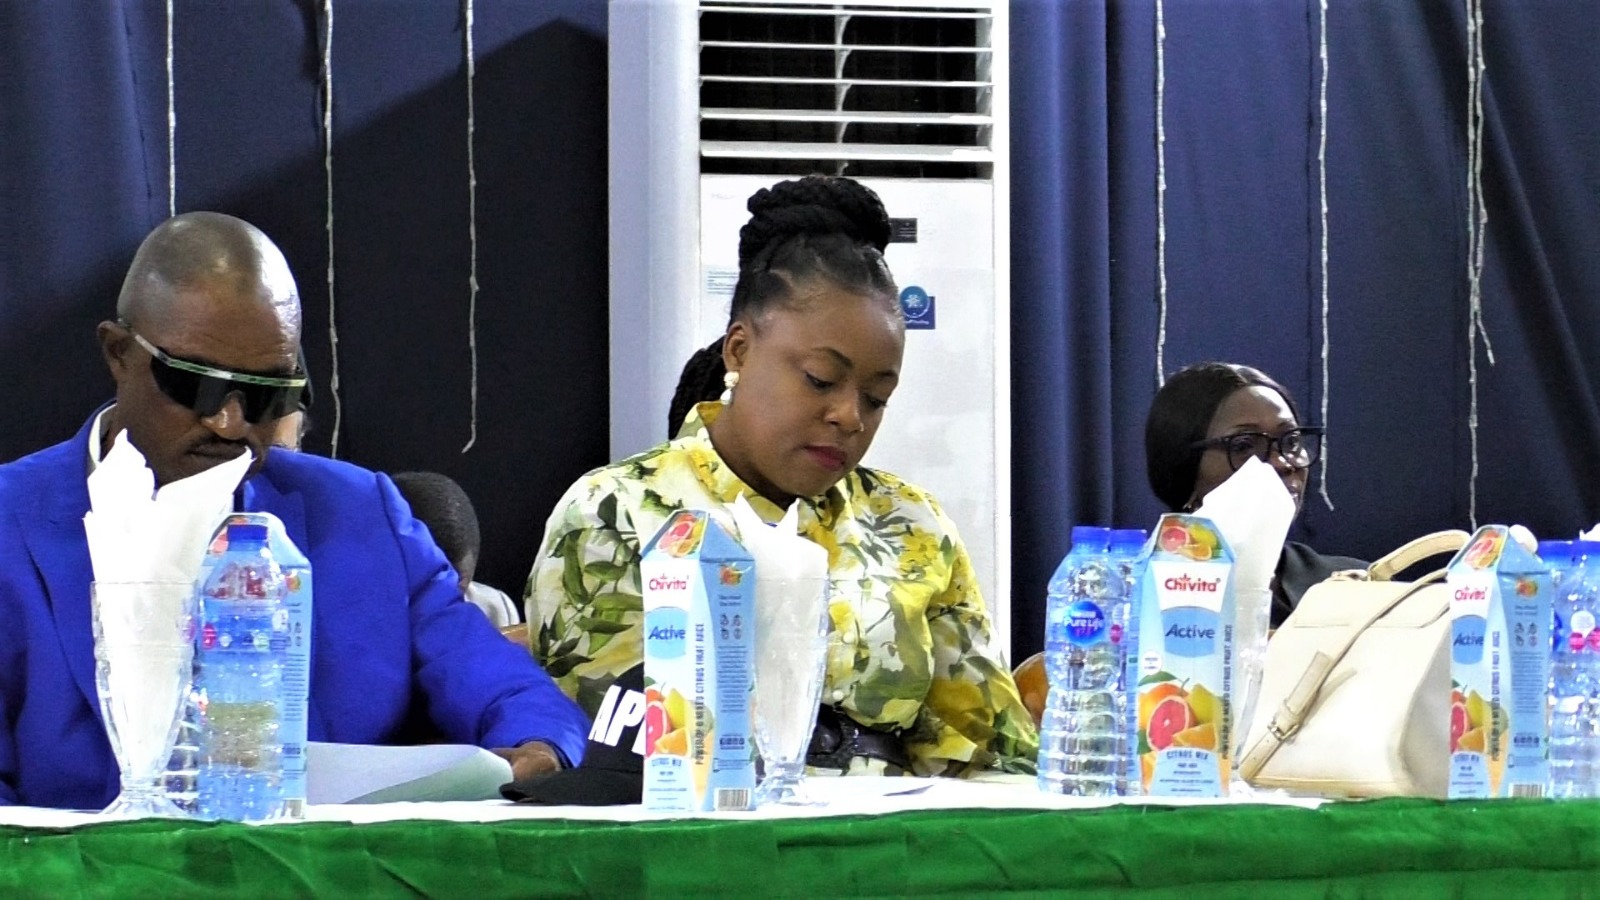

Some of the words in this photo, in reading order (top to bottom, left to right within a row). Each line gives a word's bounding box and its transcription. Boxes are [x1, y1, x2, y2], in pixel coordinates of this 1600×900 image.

[1164, 573, 1218, 592] Chivita
[648, 625, 686, 640] Active
[1165, 623, 1215, 639] Active
[588, 684, 646, 755] AP
